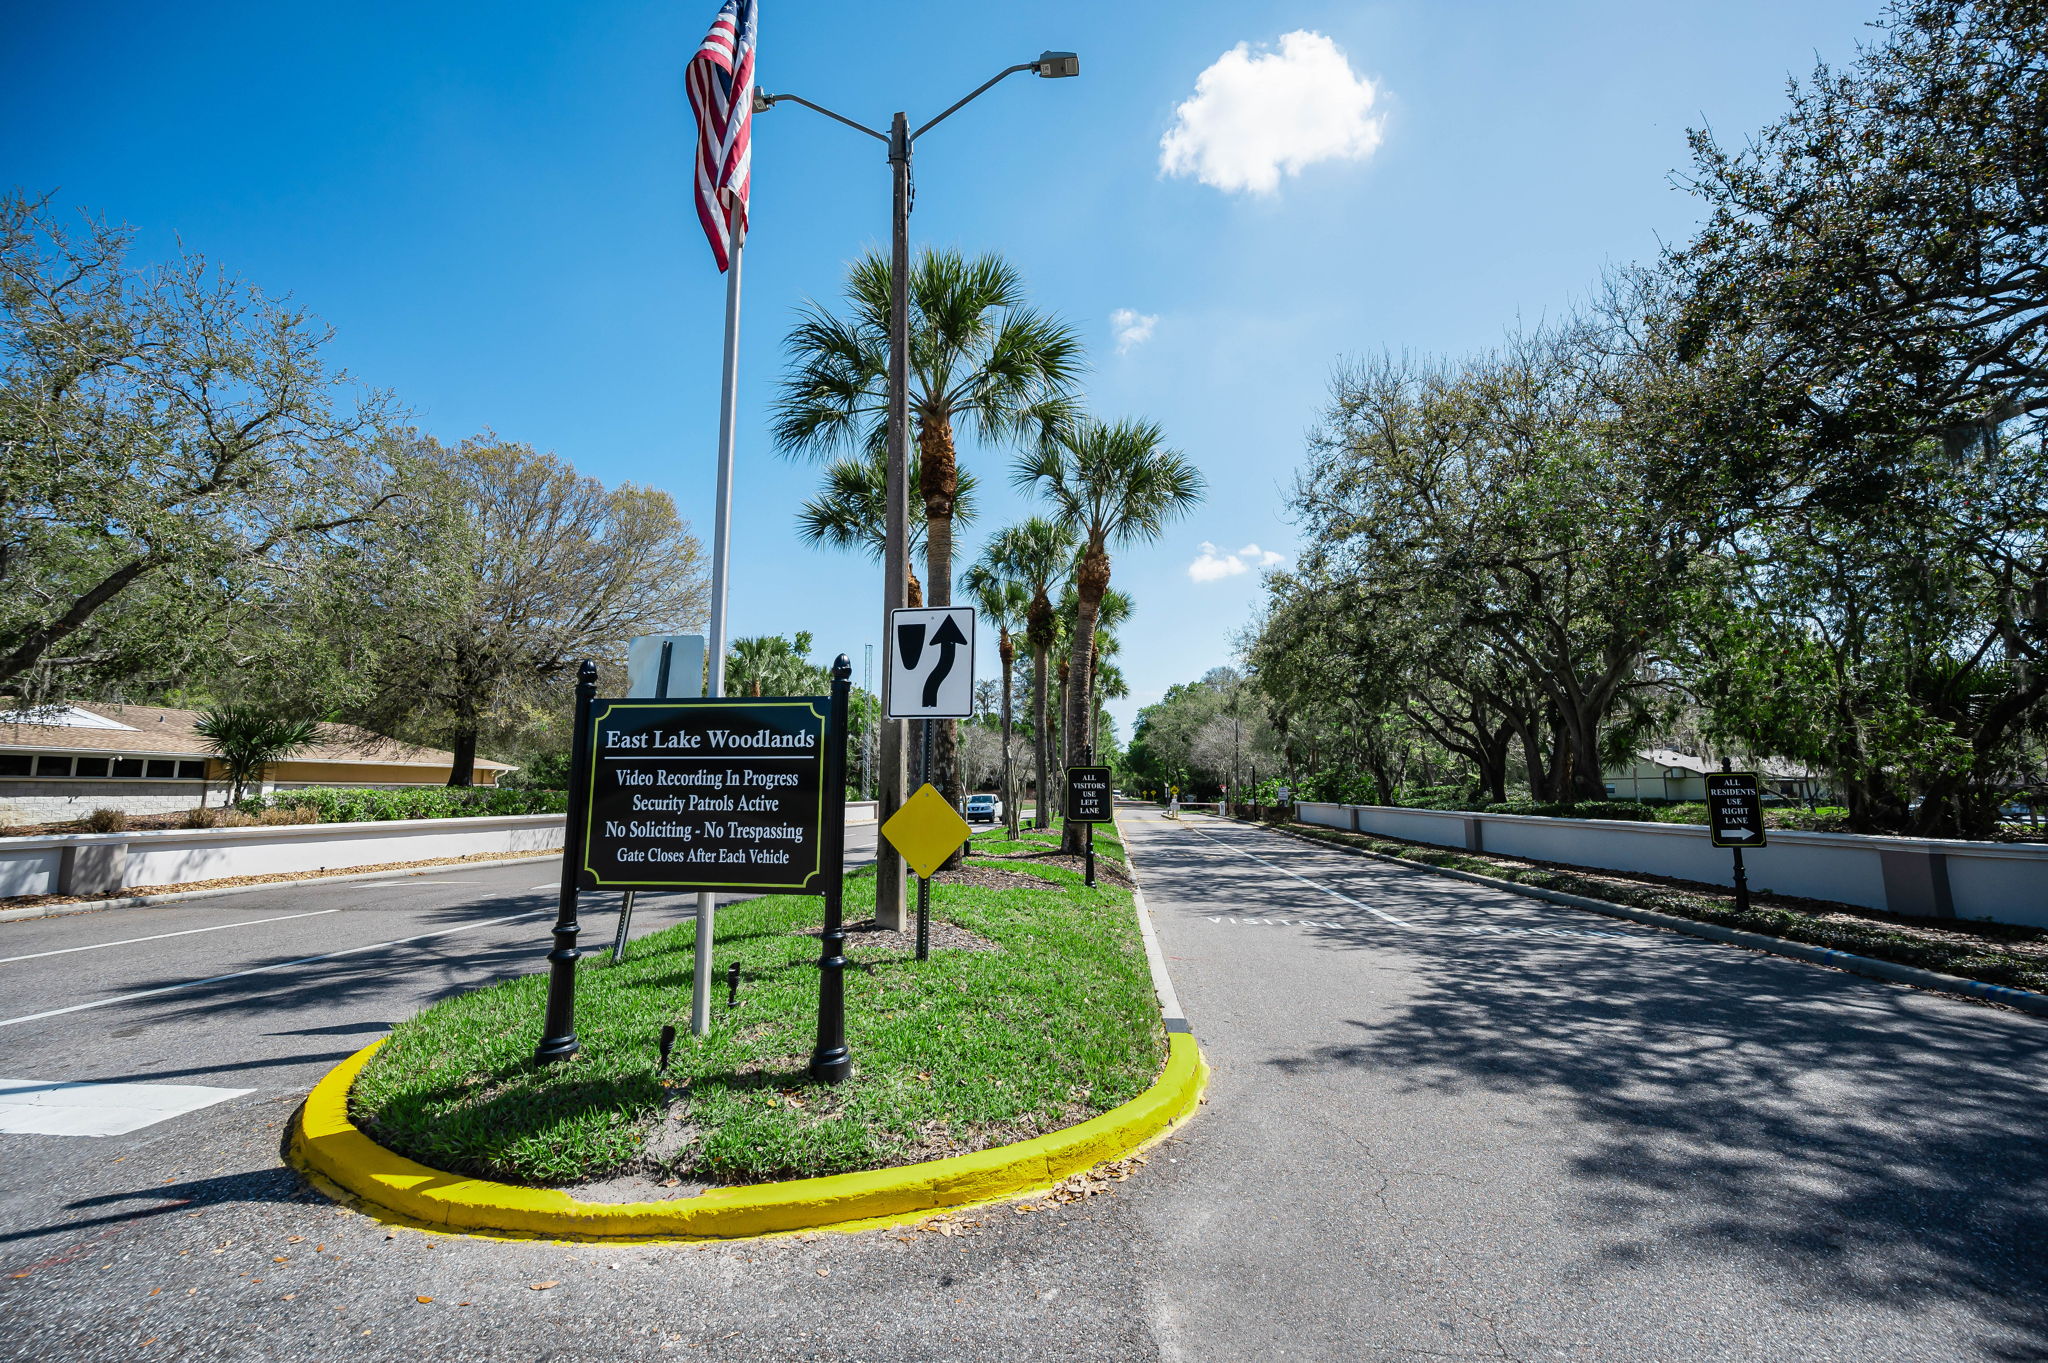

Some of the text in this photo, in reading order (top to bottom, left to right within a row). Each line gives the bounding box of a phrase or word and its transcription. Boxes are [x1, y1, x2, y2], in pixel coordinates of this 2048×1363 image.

[606, 729, 814, 748] East Lake Woodlands
[616, 770, 798, 790] Video Recording In Progress
[1082, 790, 1096, 798] USE
[1710, 788, 1756, 796] RESIDENTS
[633, 795, 778, 814] Security Patrols Active
[1721, 807, 1749, 815] RIGHT
[605, 821, 625, 837] No
[630, 821, 692, 841] Soliciting
[704, 822, 723, 838] No
[728, 822, 803, 843] Trespassing
[617, 848, 789, 864] Gate Closes After Each Vehicle
